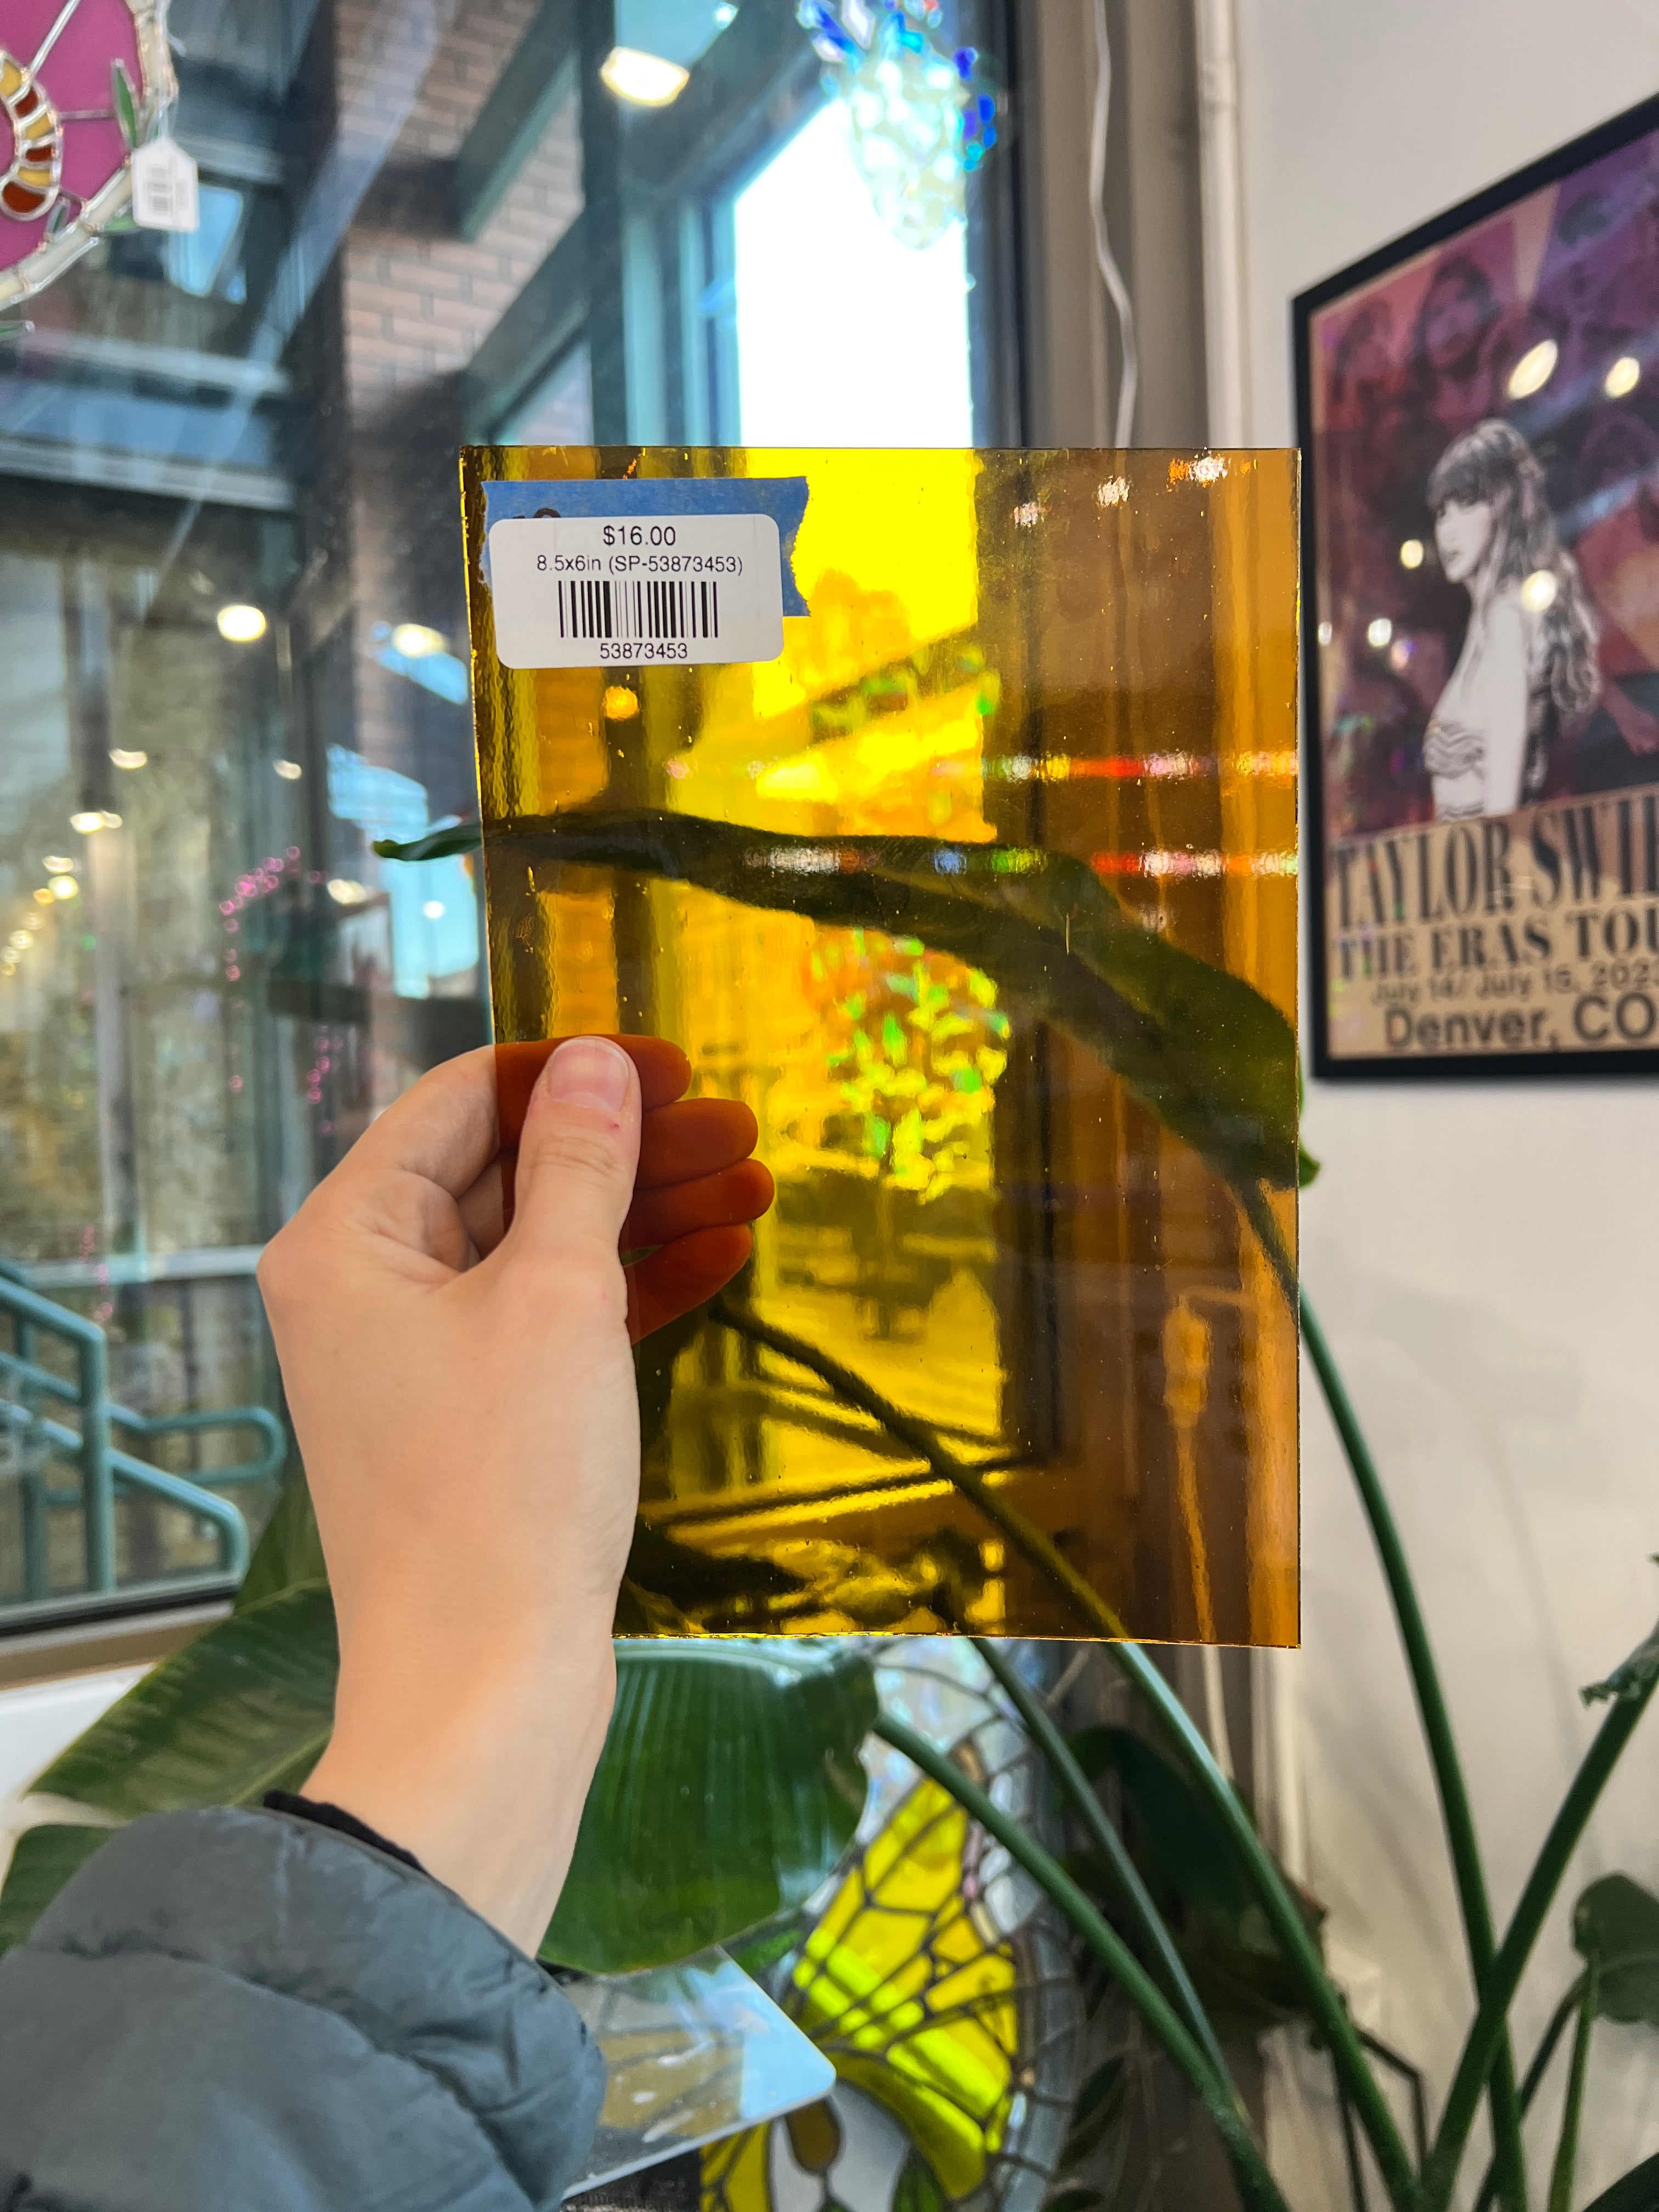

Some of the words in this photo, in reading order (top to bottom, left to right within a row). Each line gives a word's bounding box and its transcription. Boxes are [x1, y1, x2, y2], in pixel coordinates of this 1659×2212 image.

[603, 525, 676, 547] $16.00
[536, 555, 601, 572] 8.5x6in
[608, 555, 743, 576] (SP-53873453)
[600, 643, 689, 659] 53873453
[1331, 823, 1516, 929] TAYLOR
[1333, 931, 1418, 980] THE
[1430, 919, 1554, 970] ERAS
[1477, 970, 1533, 1000] July
[1384, 1005, 1561, 1051] Denver,
[1572, 991, 1658, 1042] CO
